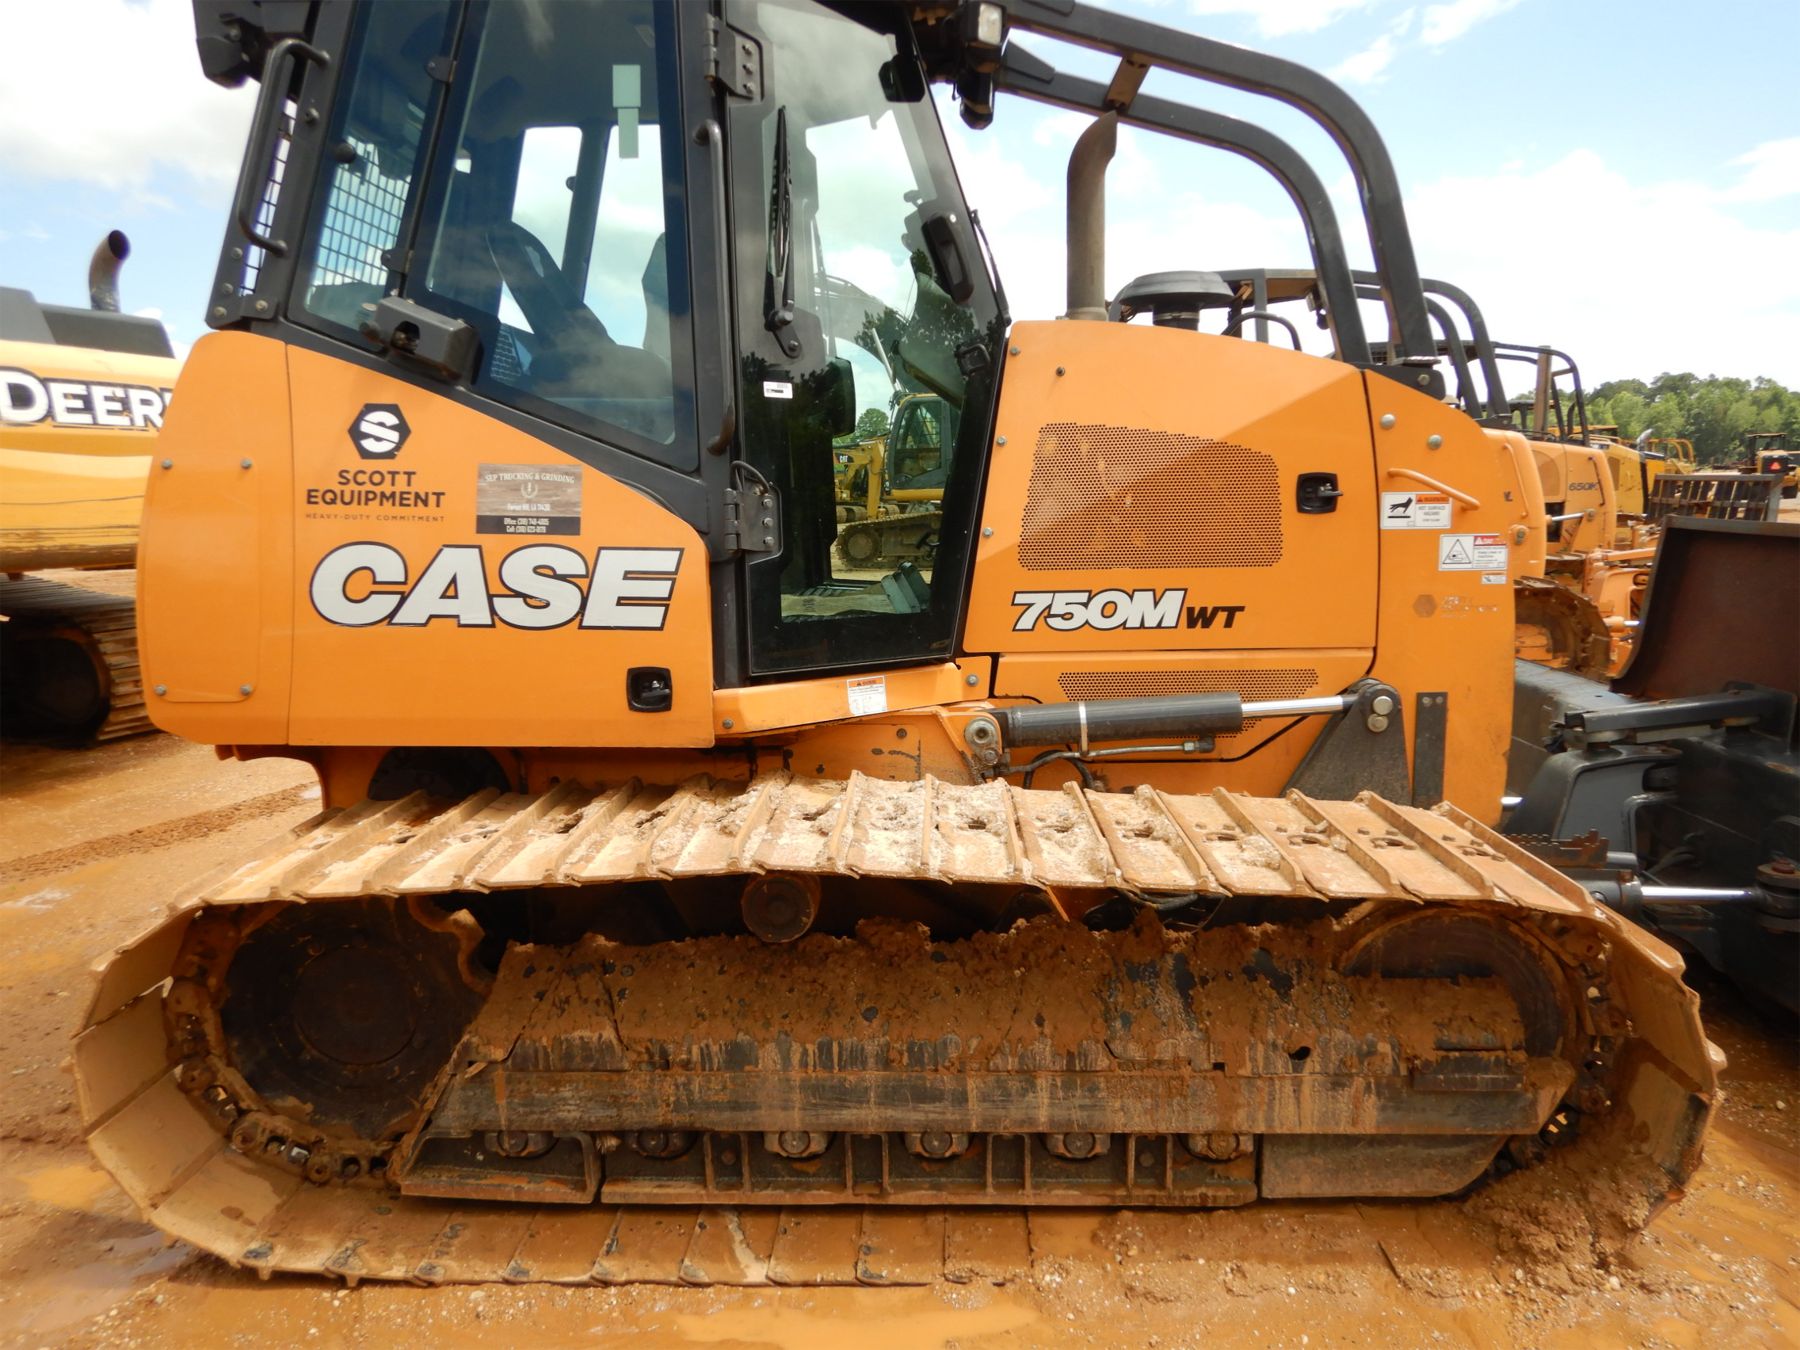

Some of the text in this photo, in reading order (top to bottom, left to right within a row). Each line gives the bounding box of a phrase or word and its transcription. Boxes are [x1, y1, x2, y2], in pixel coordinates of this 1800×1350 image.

[338, 469, 417, 487] SCOTT
[306, 489, 446, 508] EQUIPMENT
[376, 515, 445, 523] COMMITMENT
[309, 541, 684, 631] CASE
[1011, 588, 1245, 631] 750M WT
